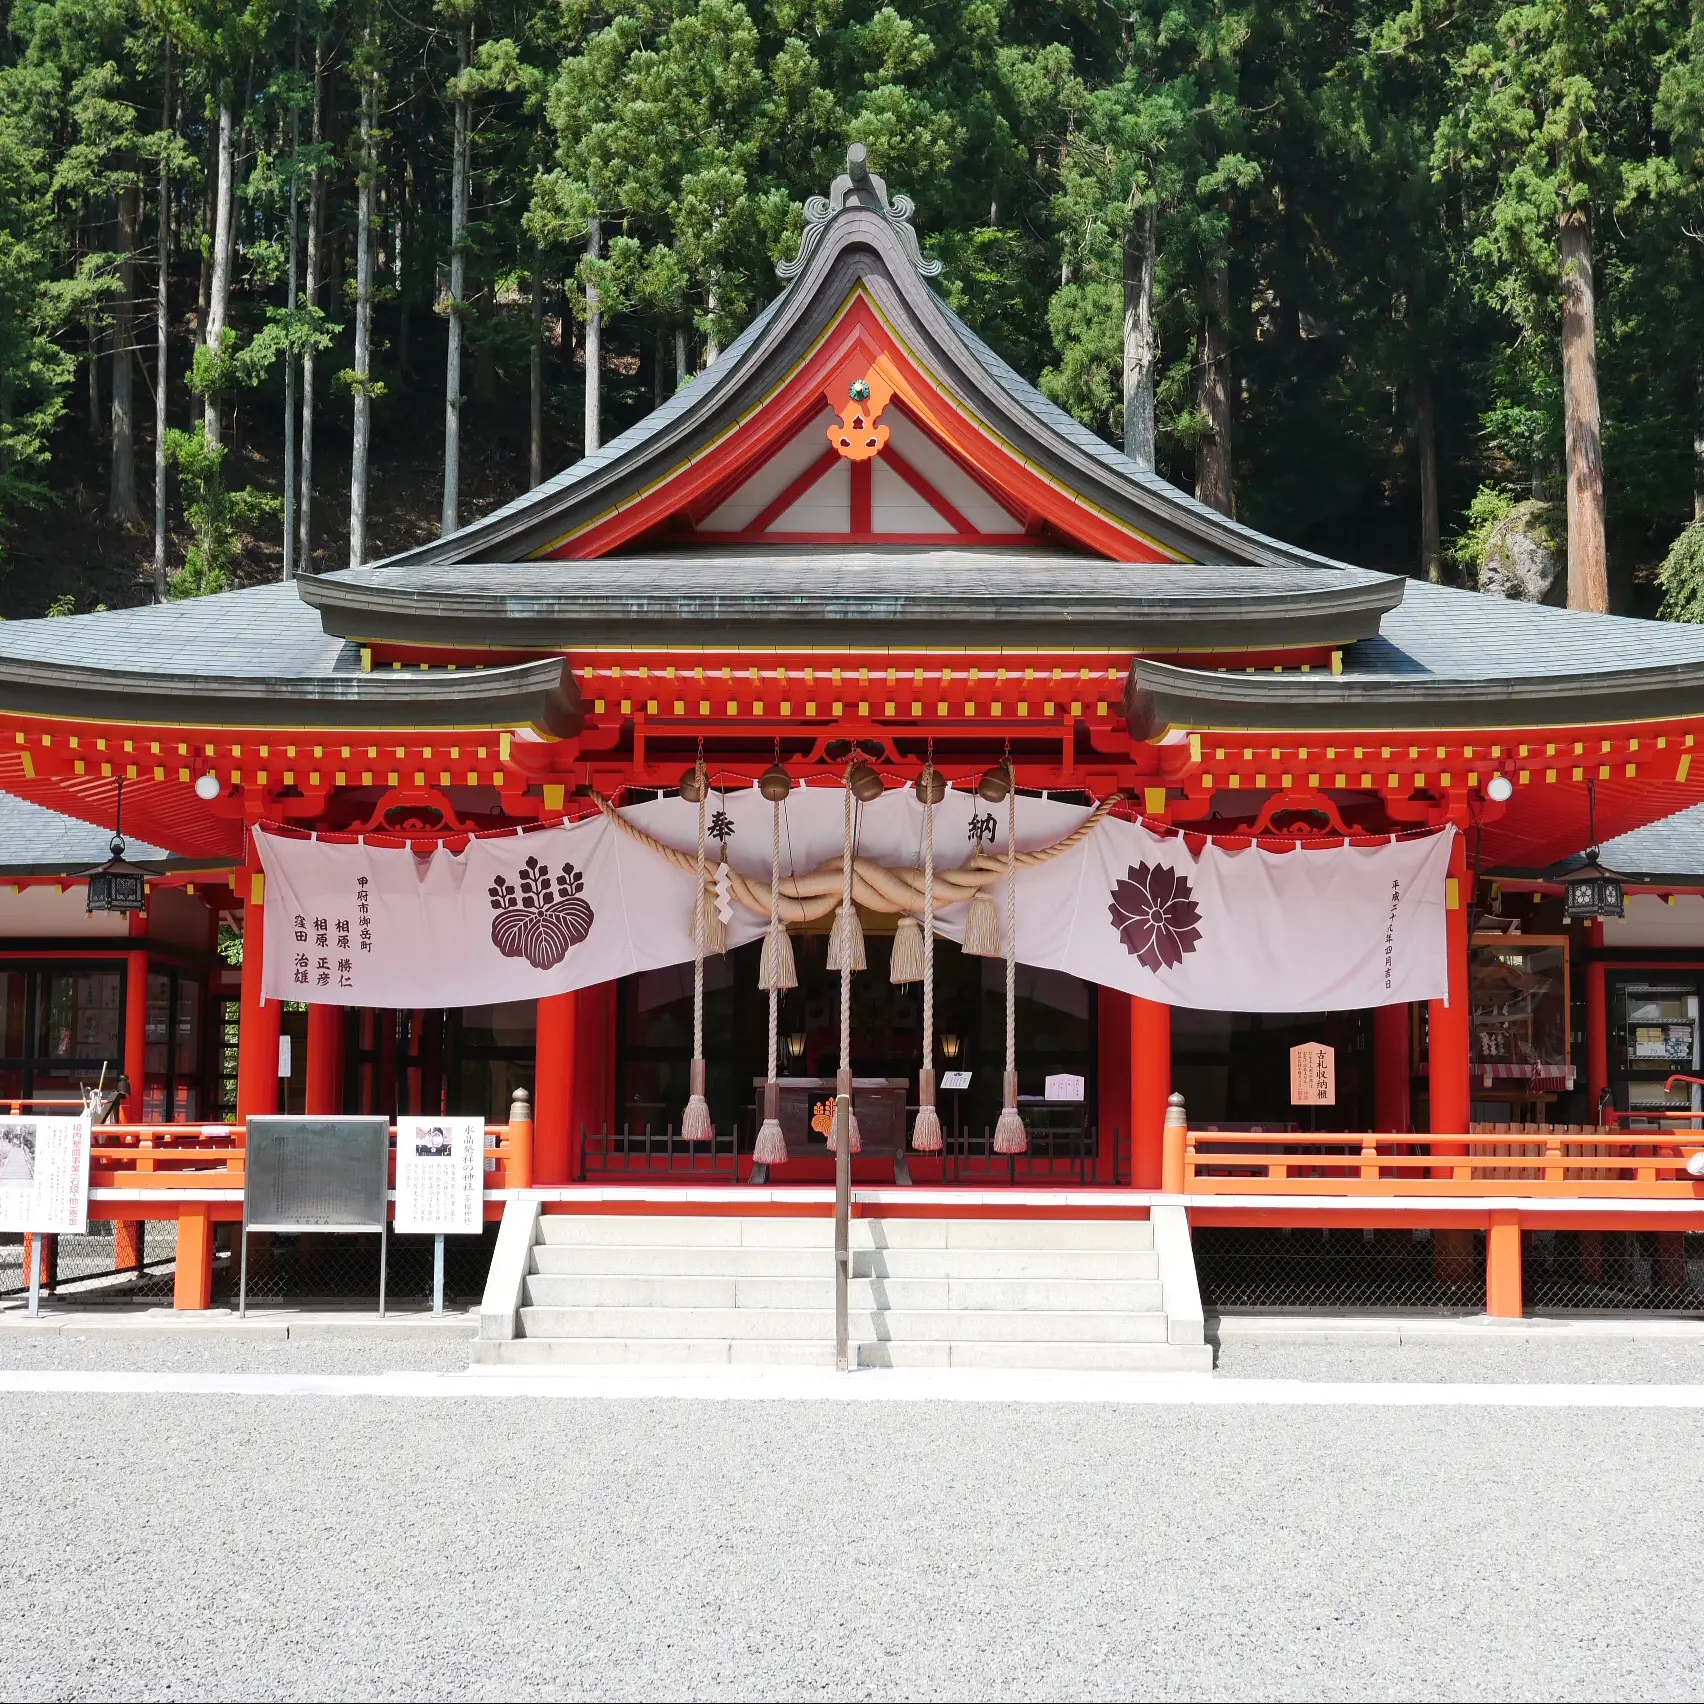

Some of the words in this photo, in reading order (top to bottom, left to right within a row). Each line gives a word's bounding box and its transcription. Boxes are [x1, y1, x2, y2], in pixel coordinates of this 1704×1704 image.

[707, 811, 736, 842] 奉
[967, 812, 998, 843] 納
[293, 914, 308, 943] 窪田
[356, 876, 373, 953] 甲府市御岳町
[312, 916, 329, 948] 相原
[335, 918, 351, 949] 相原
[293, 952, 309, 984] 治雄
[316, 957, 331, 986] 正彦
[337, 958, 353, 988] 勝仁
